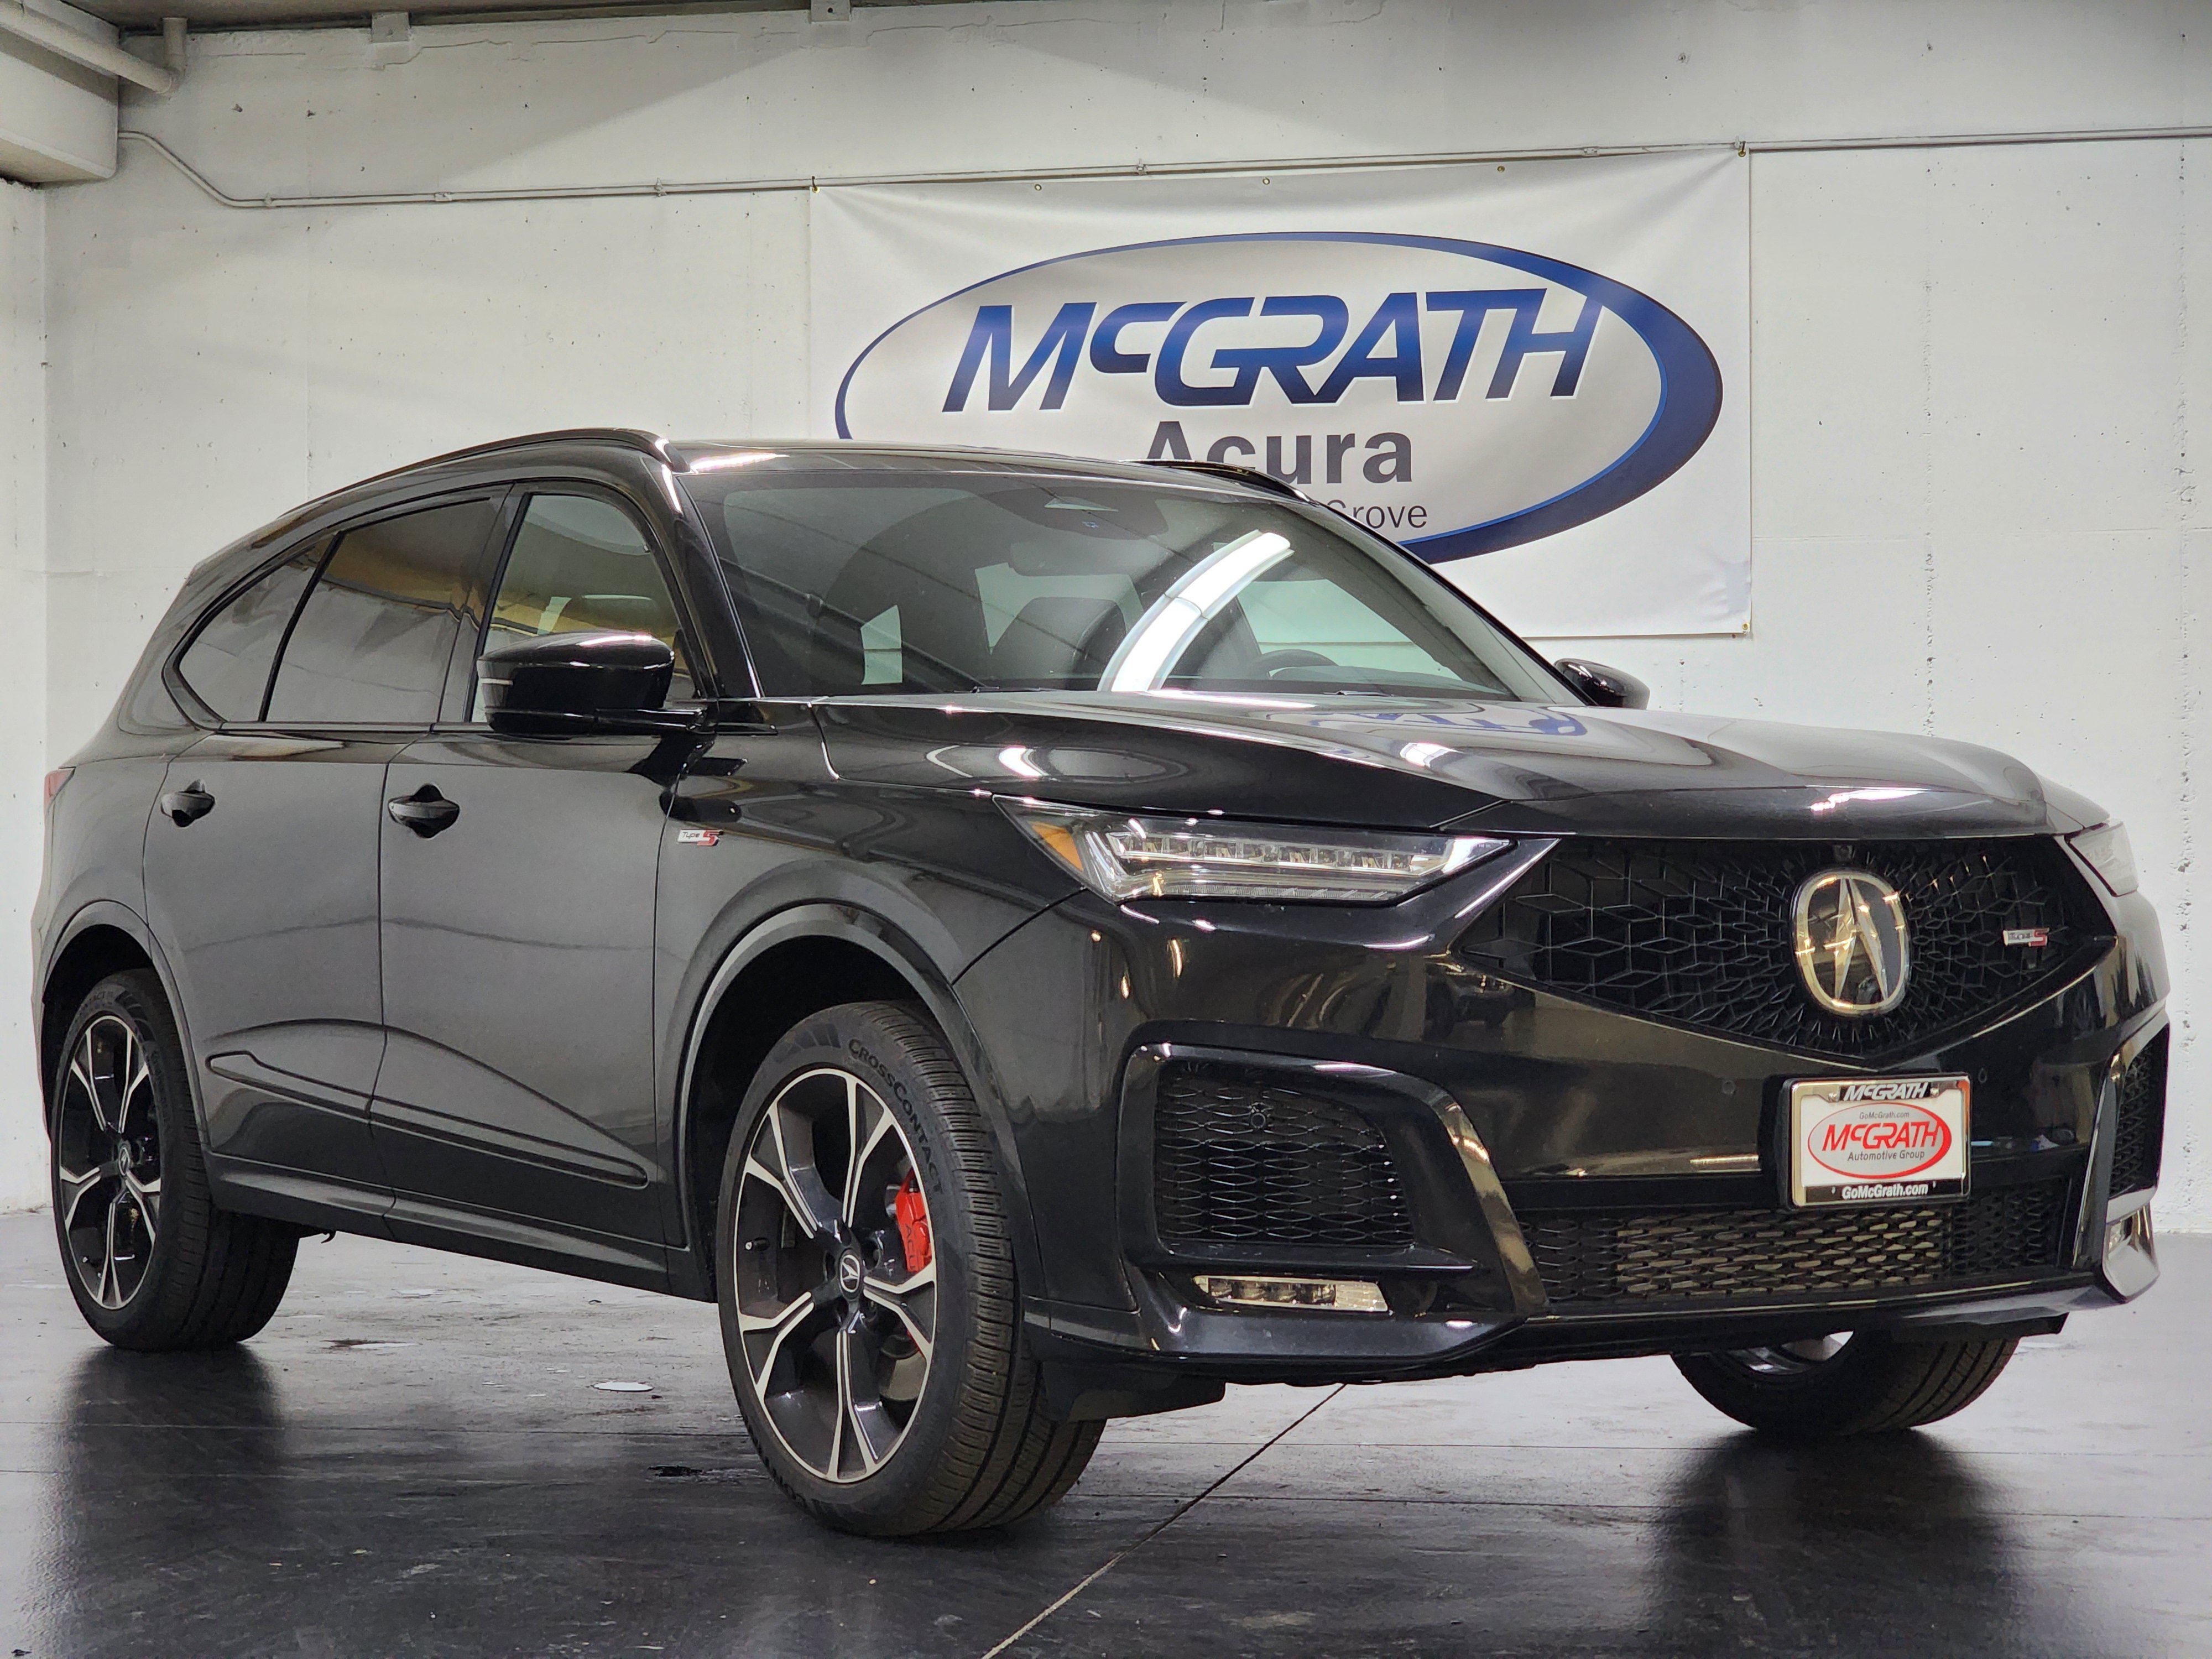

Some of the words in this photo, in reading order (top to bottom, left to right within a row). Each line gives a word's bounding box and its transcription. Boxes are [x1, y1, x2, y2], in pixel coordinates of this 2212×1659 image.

[682, 831, 701, 839] Type
[1859, 1111, 1910, 1120] GoMcGrath.com
[1848, 1150, 1897, 1161] Automotive
[1899, 1150, 1925, 1161] Group
[1841, 1183, 1928, 1200] GoMcGrath.com
[905, 1223, 916, 1269] ACU
